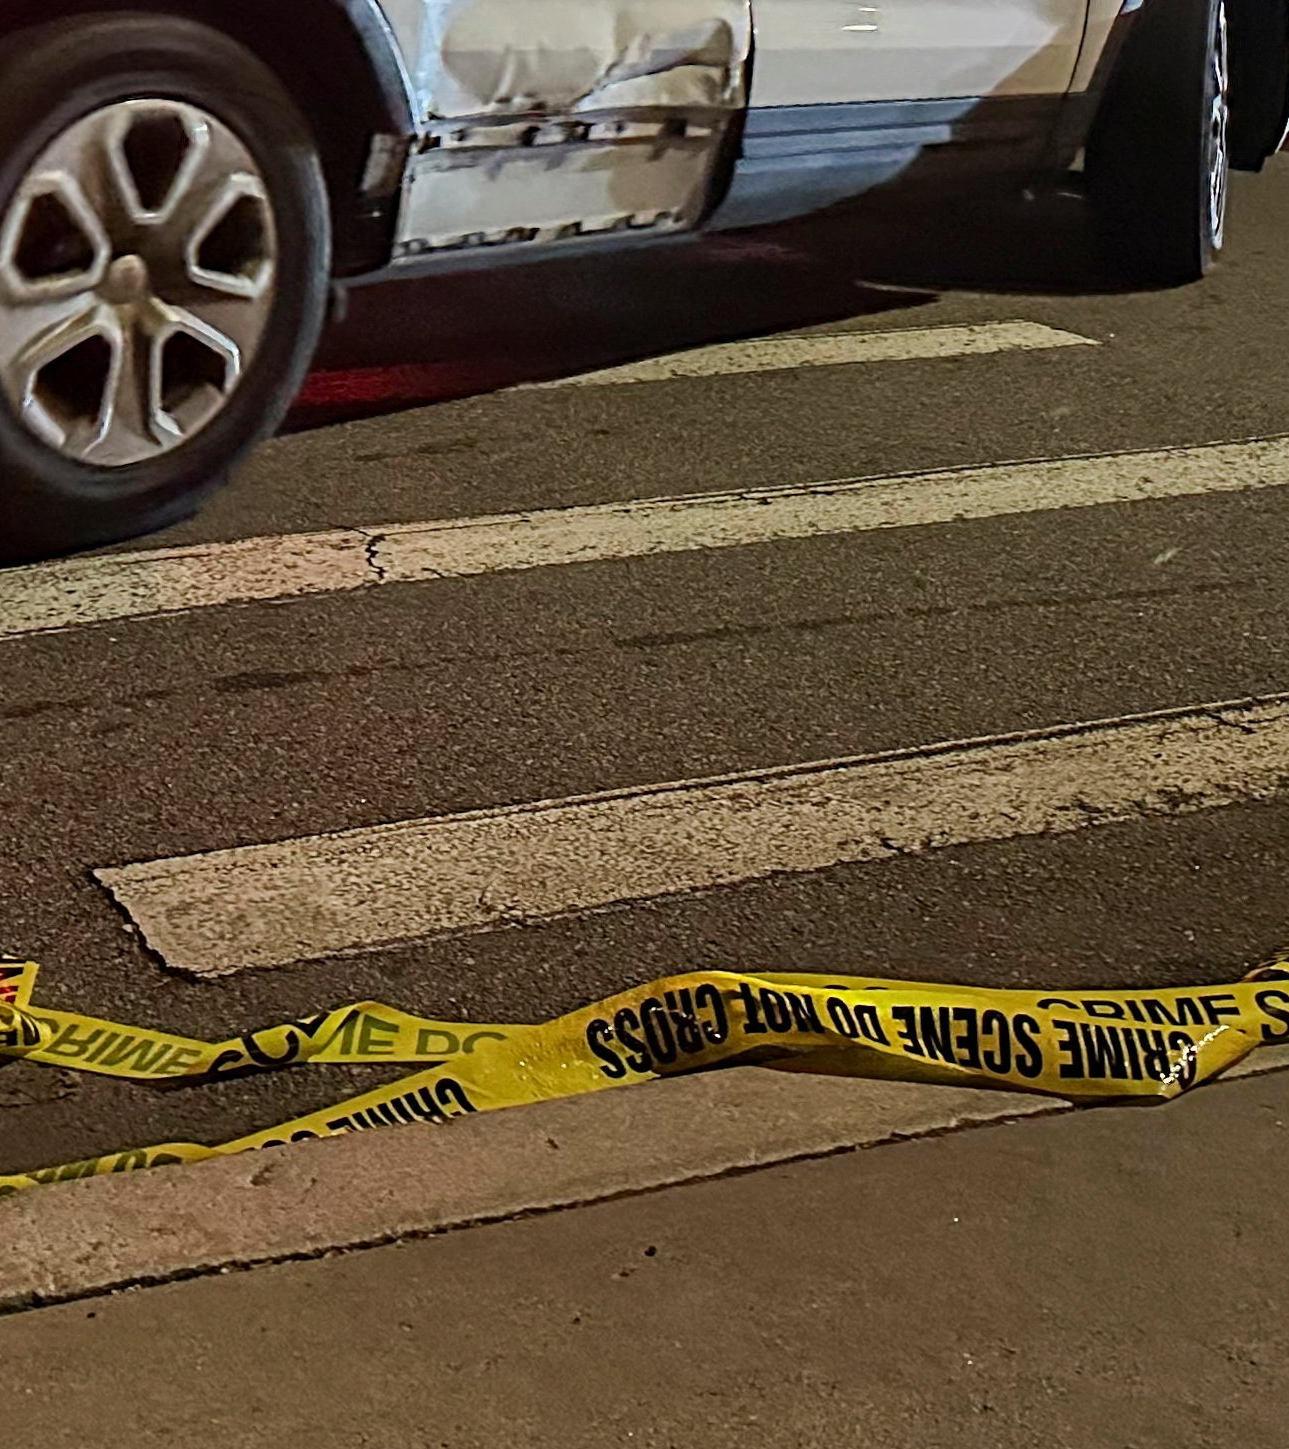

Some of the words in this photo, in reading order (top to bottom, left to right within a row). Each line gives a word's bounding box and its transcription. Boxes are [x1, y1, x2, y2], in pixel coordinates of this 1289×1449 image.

[585, 983, 730, 1079] CROSS
[738, 982, 827, 1035] NOT
[826, 996, 890, 1047] DO
[892, 1005, 1045, 1079] SCENE
